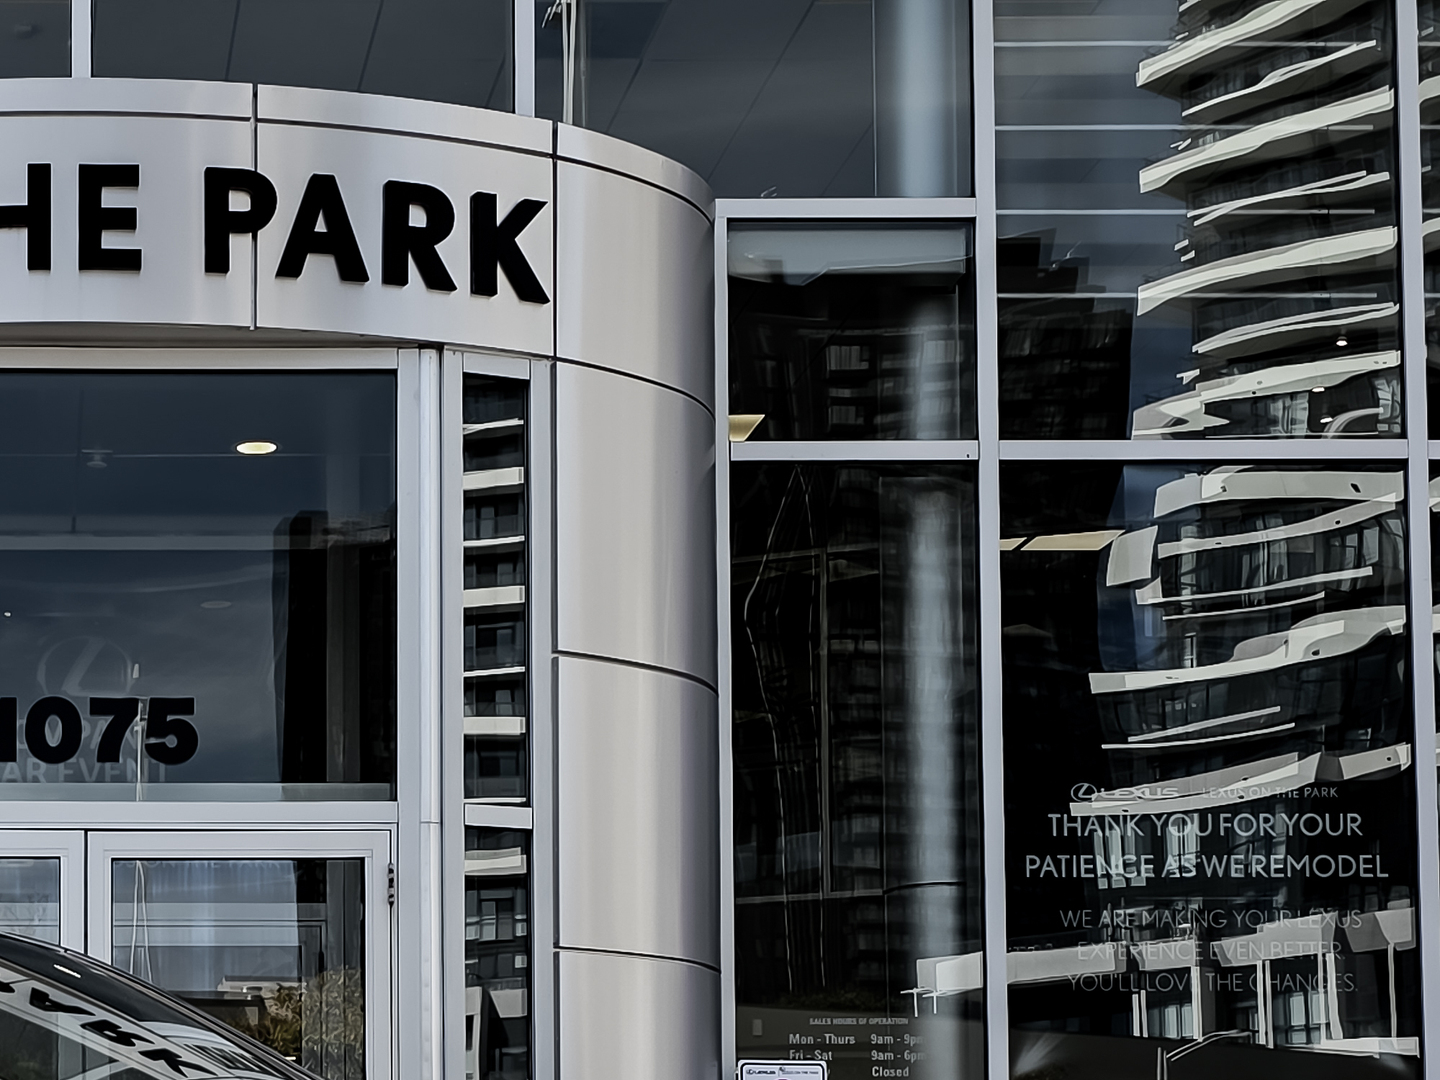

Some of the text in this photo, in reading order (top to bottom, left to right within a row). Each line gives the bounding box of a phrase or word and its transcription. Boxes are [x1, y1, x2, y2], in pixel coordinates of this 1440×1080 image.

[202, 164, 552, 305] PARK
[1100, 787, 1179, 799] LEXUS
[1303, 786, 1339, 798] PARK
[1047, 812, 1364, 837] THANK YOU FOR YOUR
[1024, 854, 1390, 879] PATIENCE AS WE REMODEL
[1060, 909, 1363, 928] WE ARE MAKING YOUR LEXUS
[1077, 941, 1204, 961] EXPERIENCE
[1210, 941, 1265, 961] EVEN
[1205, 973, 1244, 992] THE
[788, 1033, 814, 1045] Mon
[823, 1033, 856, 1045] Thurs
[870, 1033, 894, 1045] 9am
[789, 1049, 804, 1060] Fri
[814, 1049, 833, 1061] Sat
[871, 1049, 894, 1061] 9am
[871, 1066, 910, 1077] Closed
